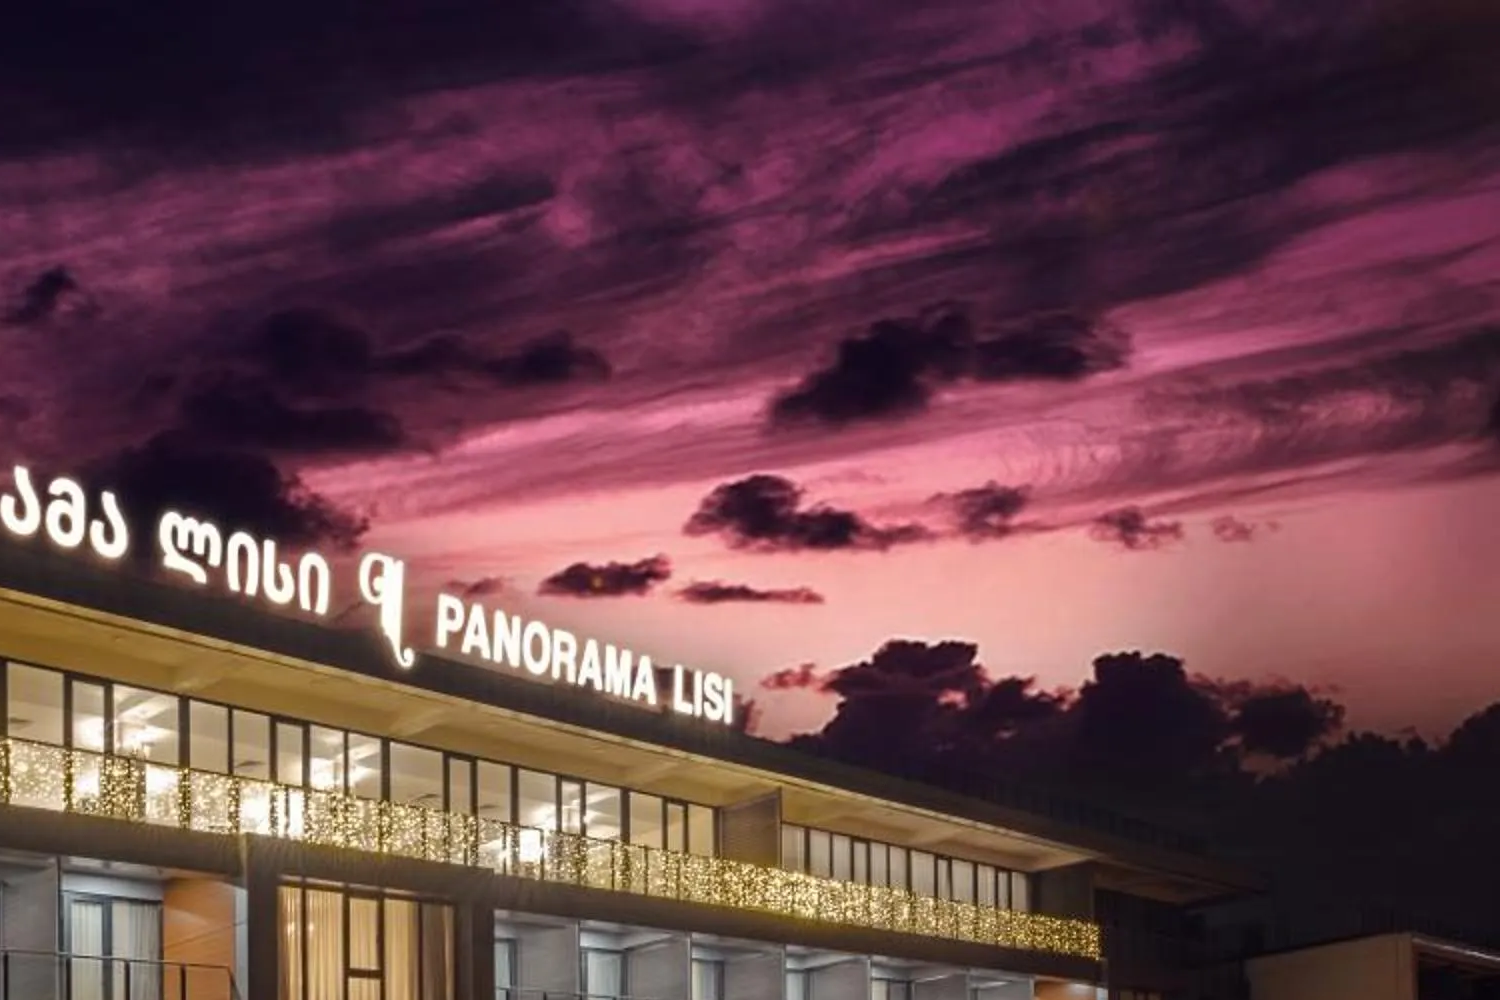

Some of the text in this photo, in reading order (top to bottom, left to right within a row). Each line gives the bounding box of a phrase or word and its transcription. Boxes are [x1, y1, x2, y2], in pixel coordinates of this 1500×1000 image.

[158, 510, 332, 617] ლისი
[435, 593, 734, 726] PANORAMA LISI
